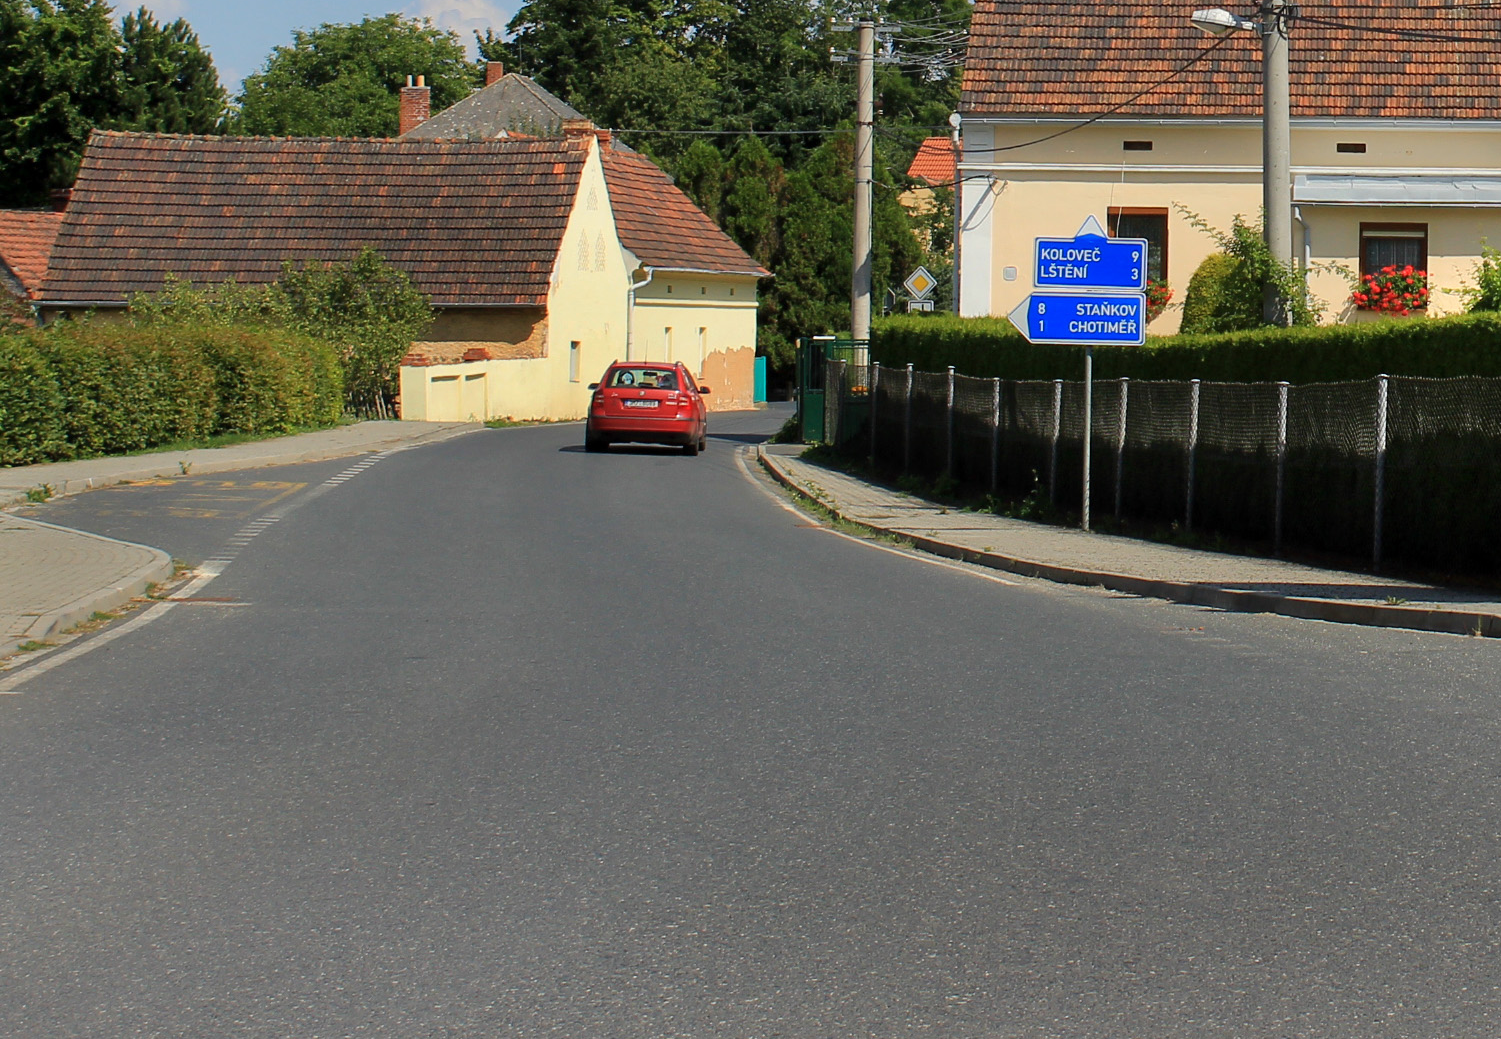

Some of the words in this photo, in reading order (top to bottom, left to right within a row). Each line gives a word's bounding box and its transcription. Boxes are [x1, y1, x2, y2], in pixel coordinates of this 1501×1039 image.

[1041, 247, 1101, 262] KOLOVEČ
[1132, 251, 1139, 262] 9
[1041, 263, 1088, 278] LŠTĚNÍ
[1131, 268, 1139, 280] 3
[1038, 303, 1046, 314] 8
[1076, 302, 1137, 316] STAŇKOV
[1039, 320, 1044, 331] 1
[1069, 319, 1137, 334] CHOTIMĚŘ
